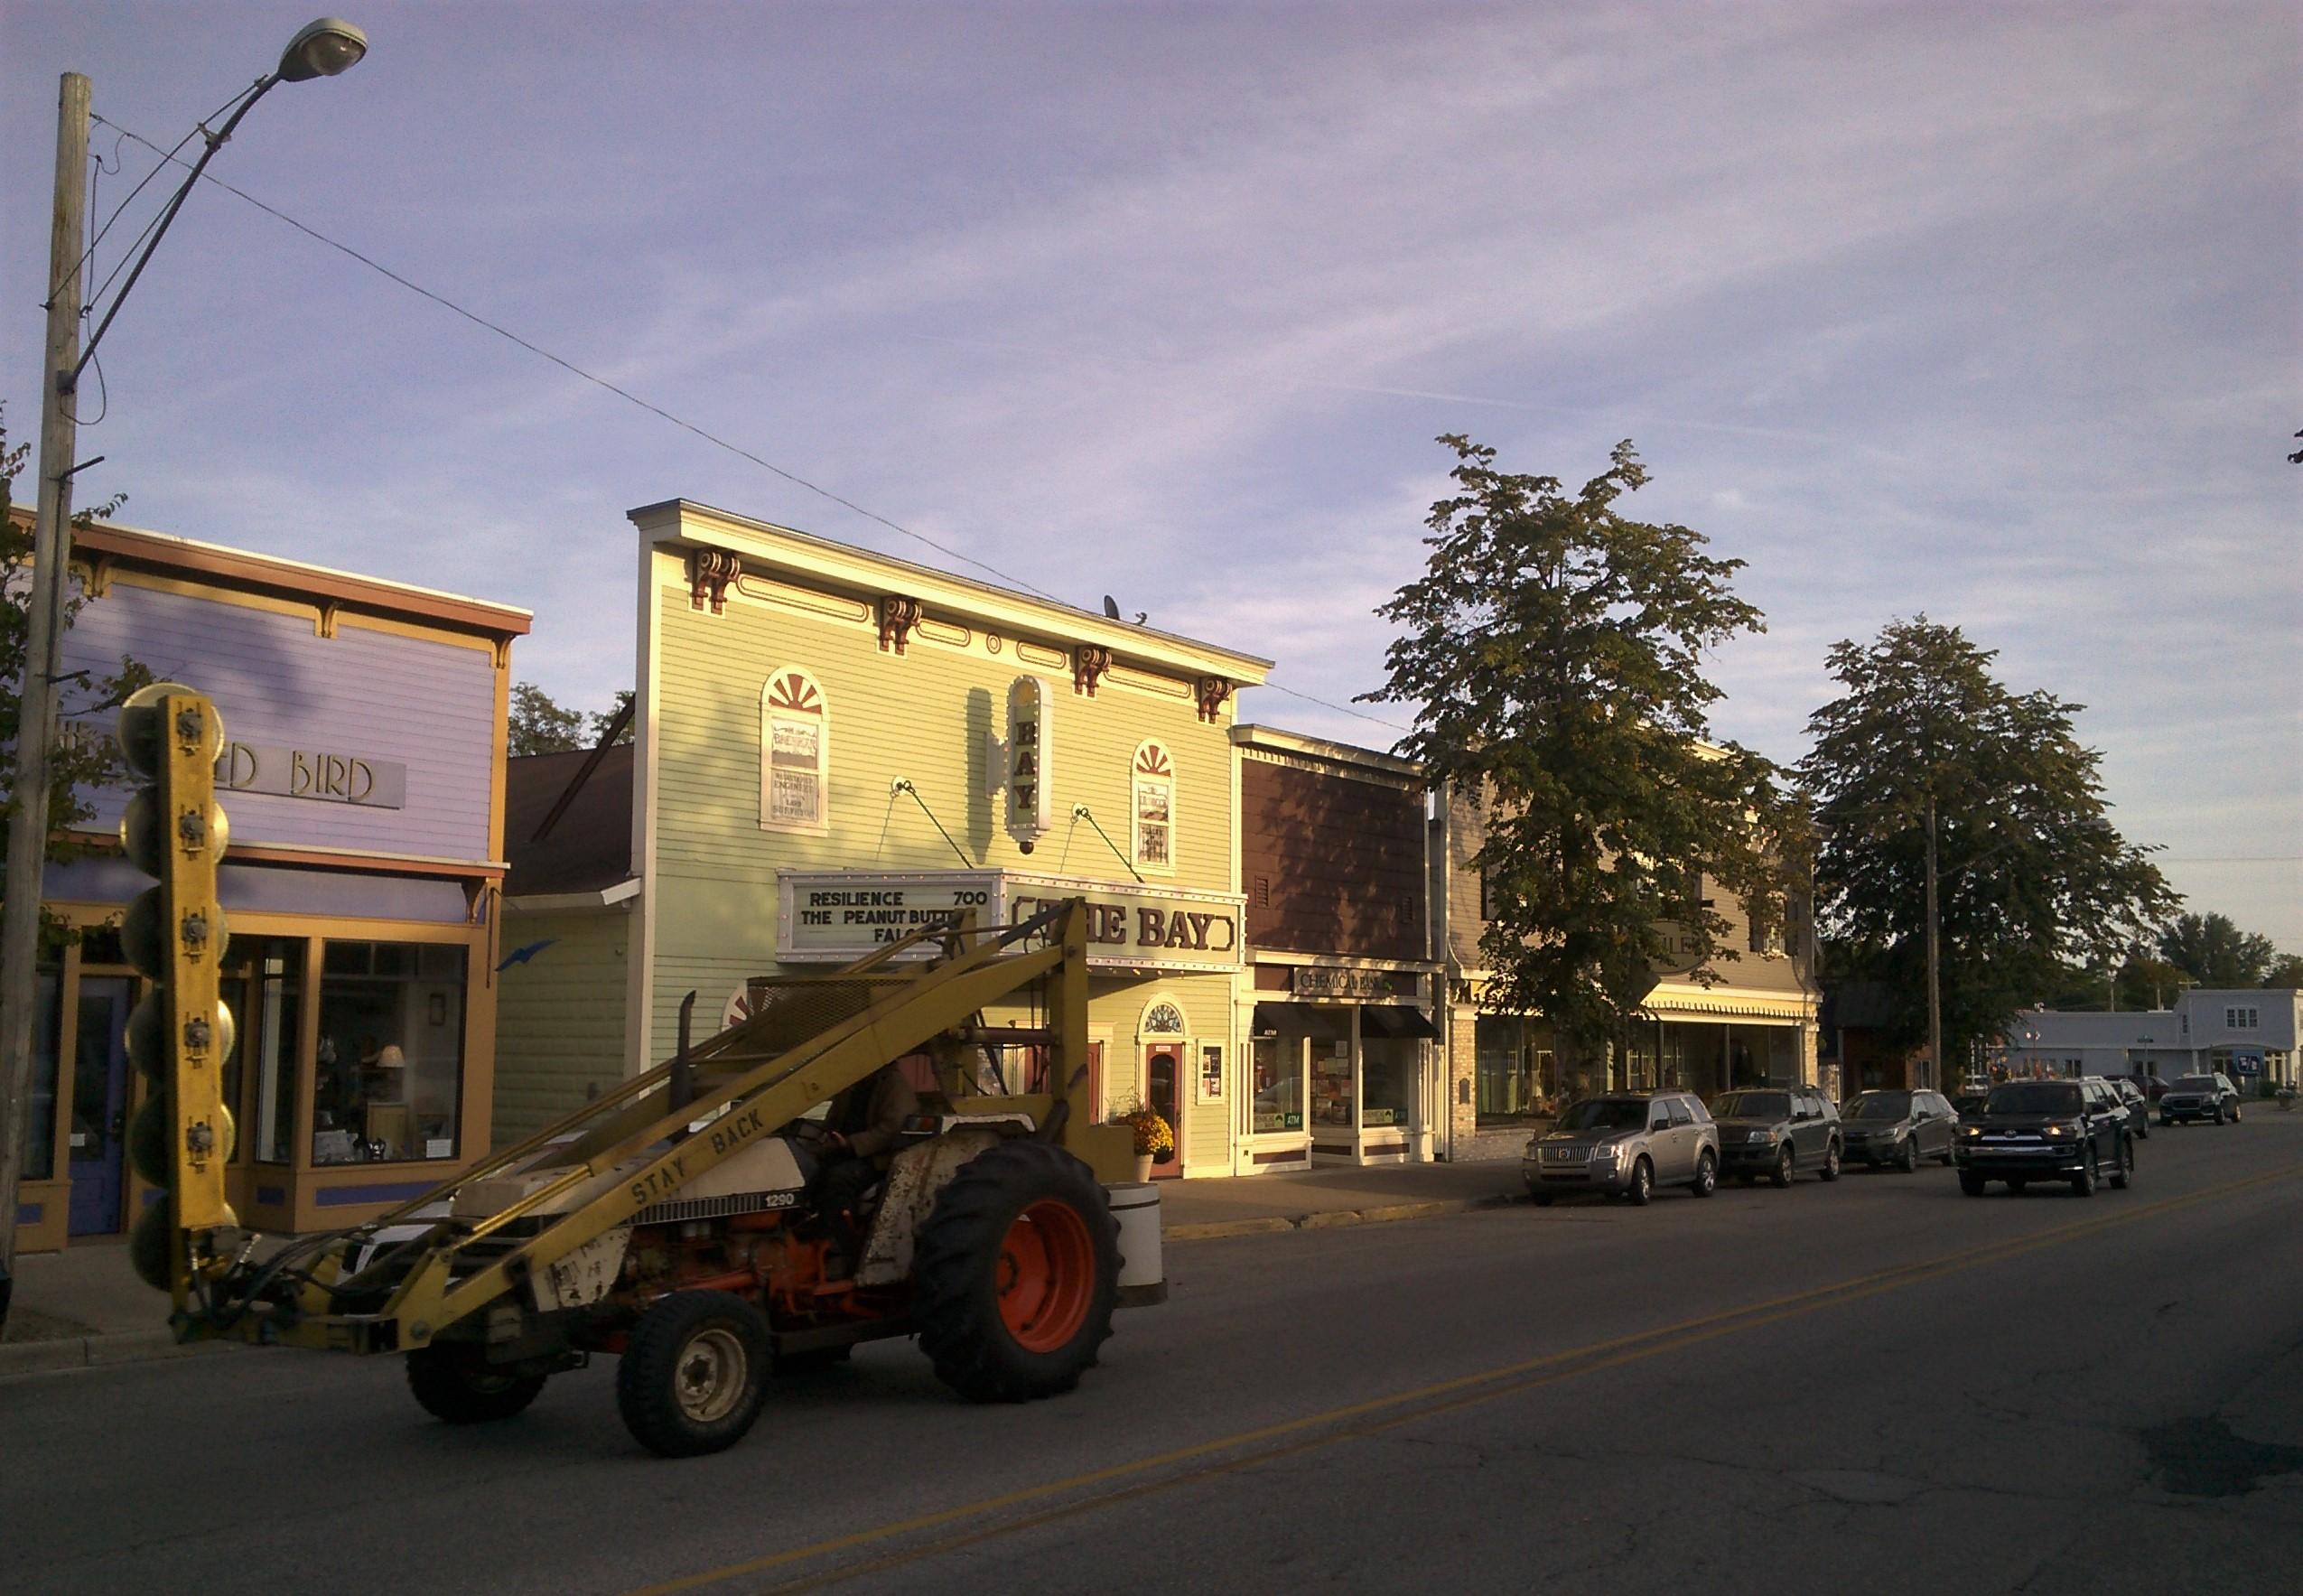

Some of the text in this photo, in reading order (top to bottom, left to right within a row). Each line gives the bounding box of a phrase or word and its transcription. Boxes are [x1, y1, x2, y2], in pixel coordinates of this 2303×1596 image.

[212, 742, 376, 802] ED BIRD
[1012, 721, 1036, 809] BAY
[809, 891, 988, 907] RESILIENCE 700
[800, 910, 958, 925] THE PEANUT BUTTE
[1136, 907, 1217, 950] BAY
[1300, 973, 1357, 991] CHEMICAL
[1287, 1115, 1301, 1125] ATM
[631, 1108, 764, 1205] STAY BACK
[765, 1193, 796, 1208] 1290
